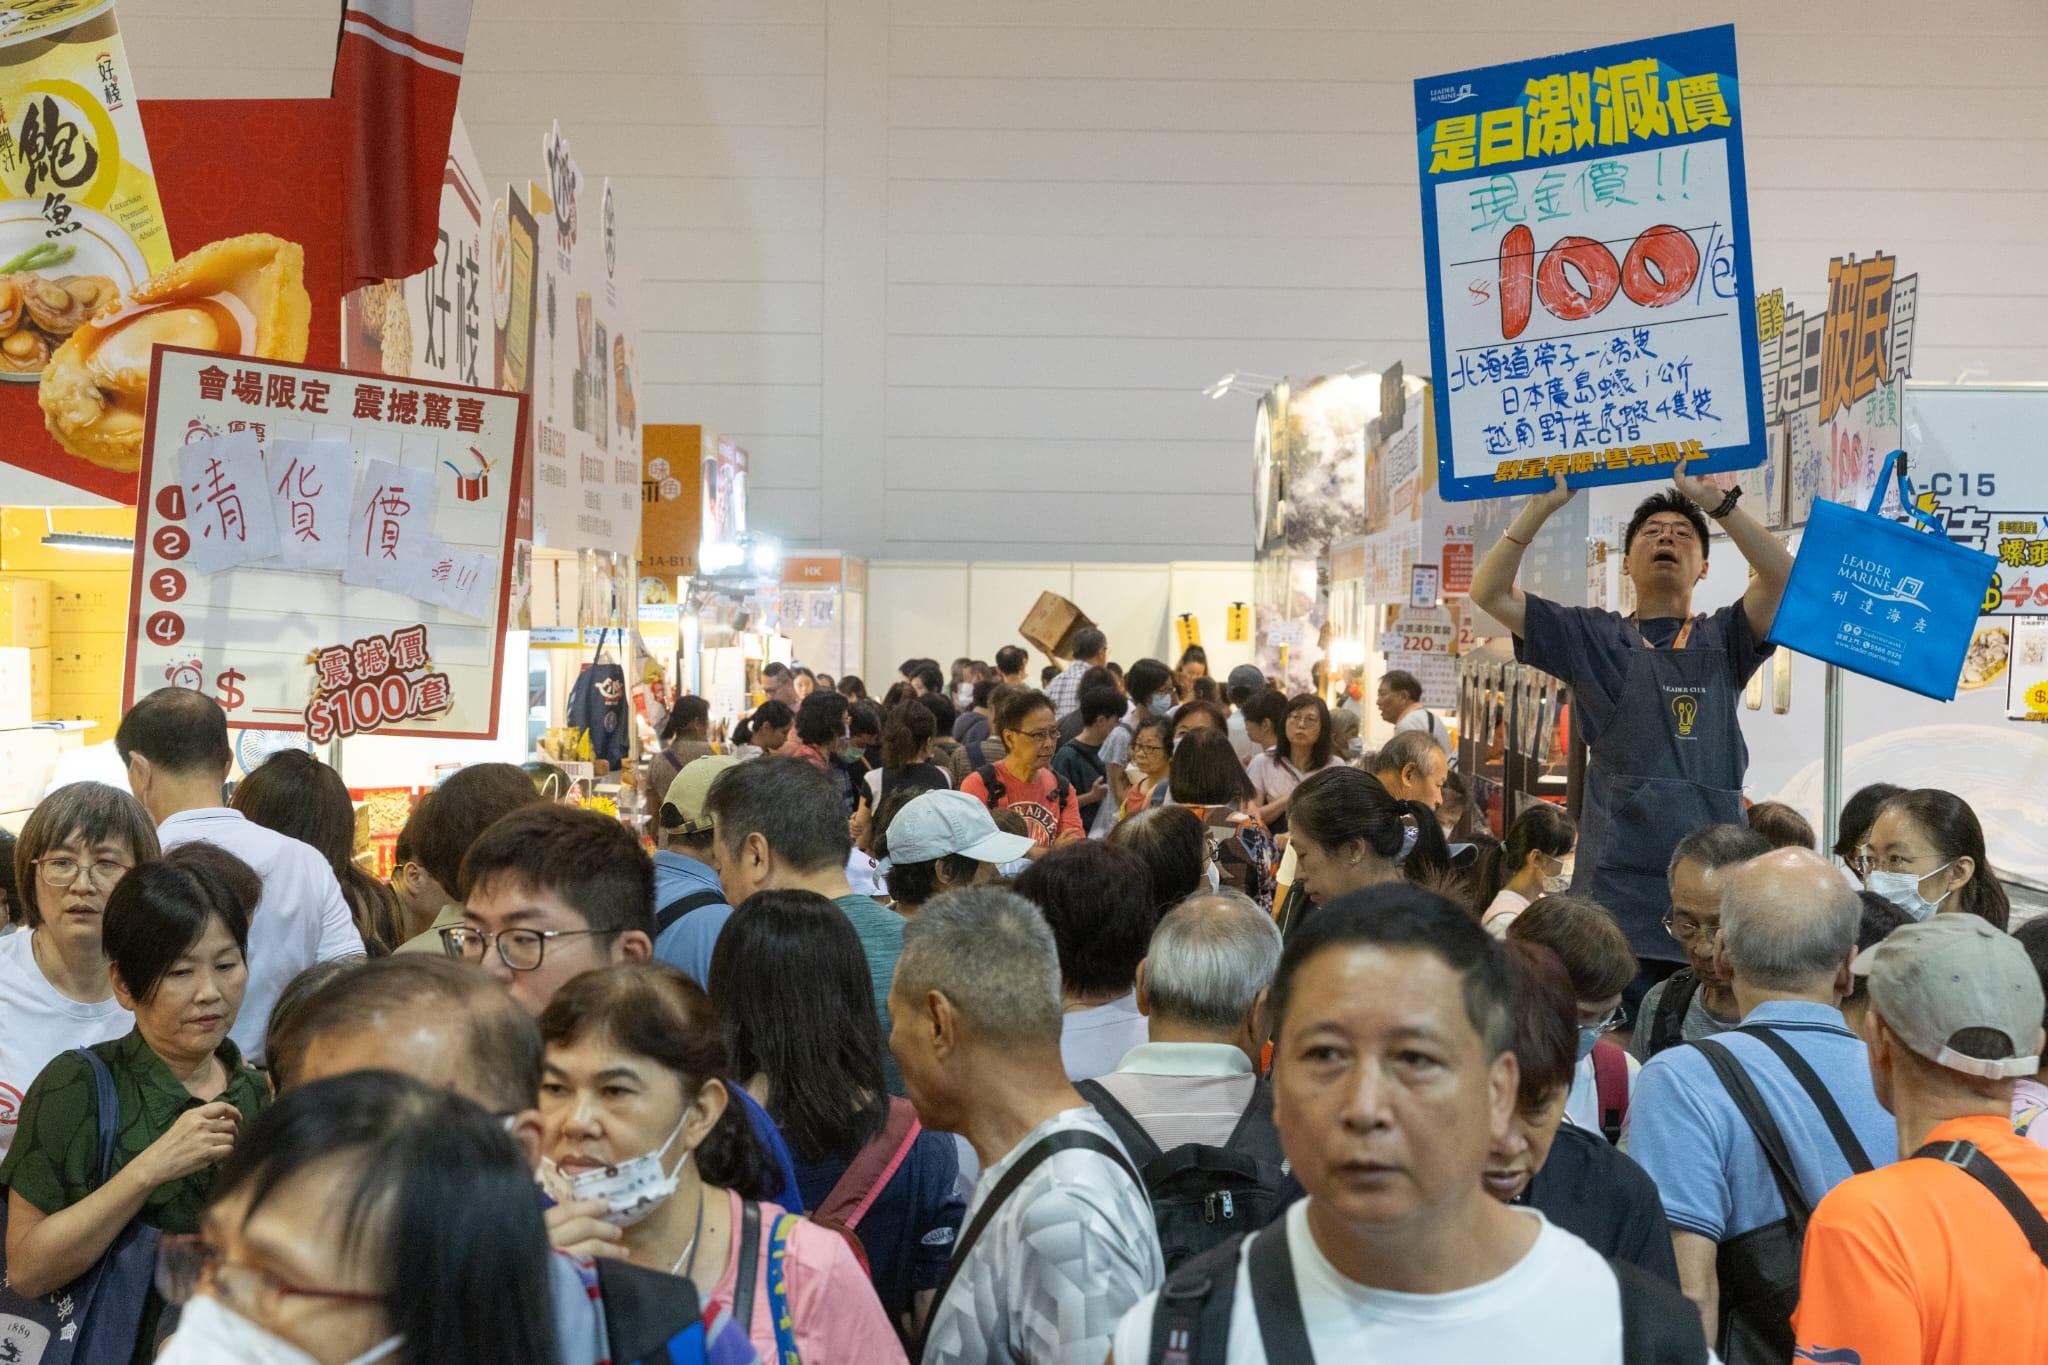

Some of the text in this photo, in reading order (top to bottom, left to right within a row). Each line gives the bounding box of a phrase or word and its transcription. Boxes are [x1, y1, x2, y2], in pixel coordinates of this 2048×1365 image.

[97, 59, 122, 105] 好棧
[1431, 86, 1455, 97] LEADER
[1431, 92, 1456, 103] MARINE
[1427, 56, 1732, 175] 是日激減價
[18, 94, 99, 239] 鮑魚
[109, 194, 143, 213] Luxurious
[119, 204, 150, 222] Premium
[199, 365, 487, 434] 會場限定 震撼驚喜
[1493, 438, 1710, 483] 數量有限!售完即止
[804, 566, 822, 577] HK
[1837, 566, 1891, 592] MARINE
[1842, 553, 1891, 579] LEADER
[1831, 590, 1927, 634] 利達海產
[320, 632, 424, 688] 震撼價
[308, 676, 447, 741] $100/套
[7, 1321, 31, 1339] 1889
